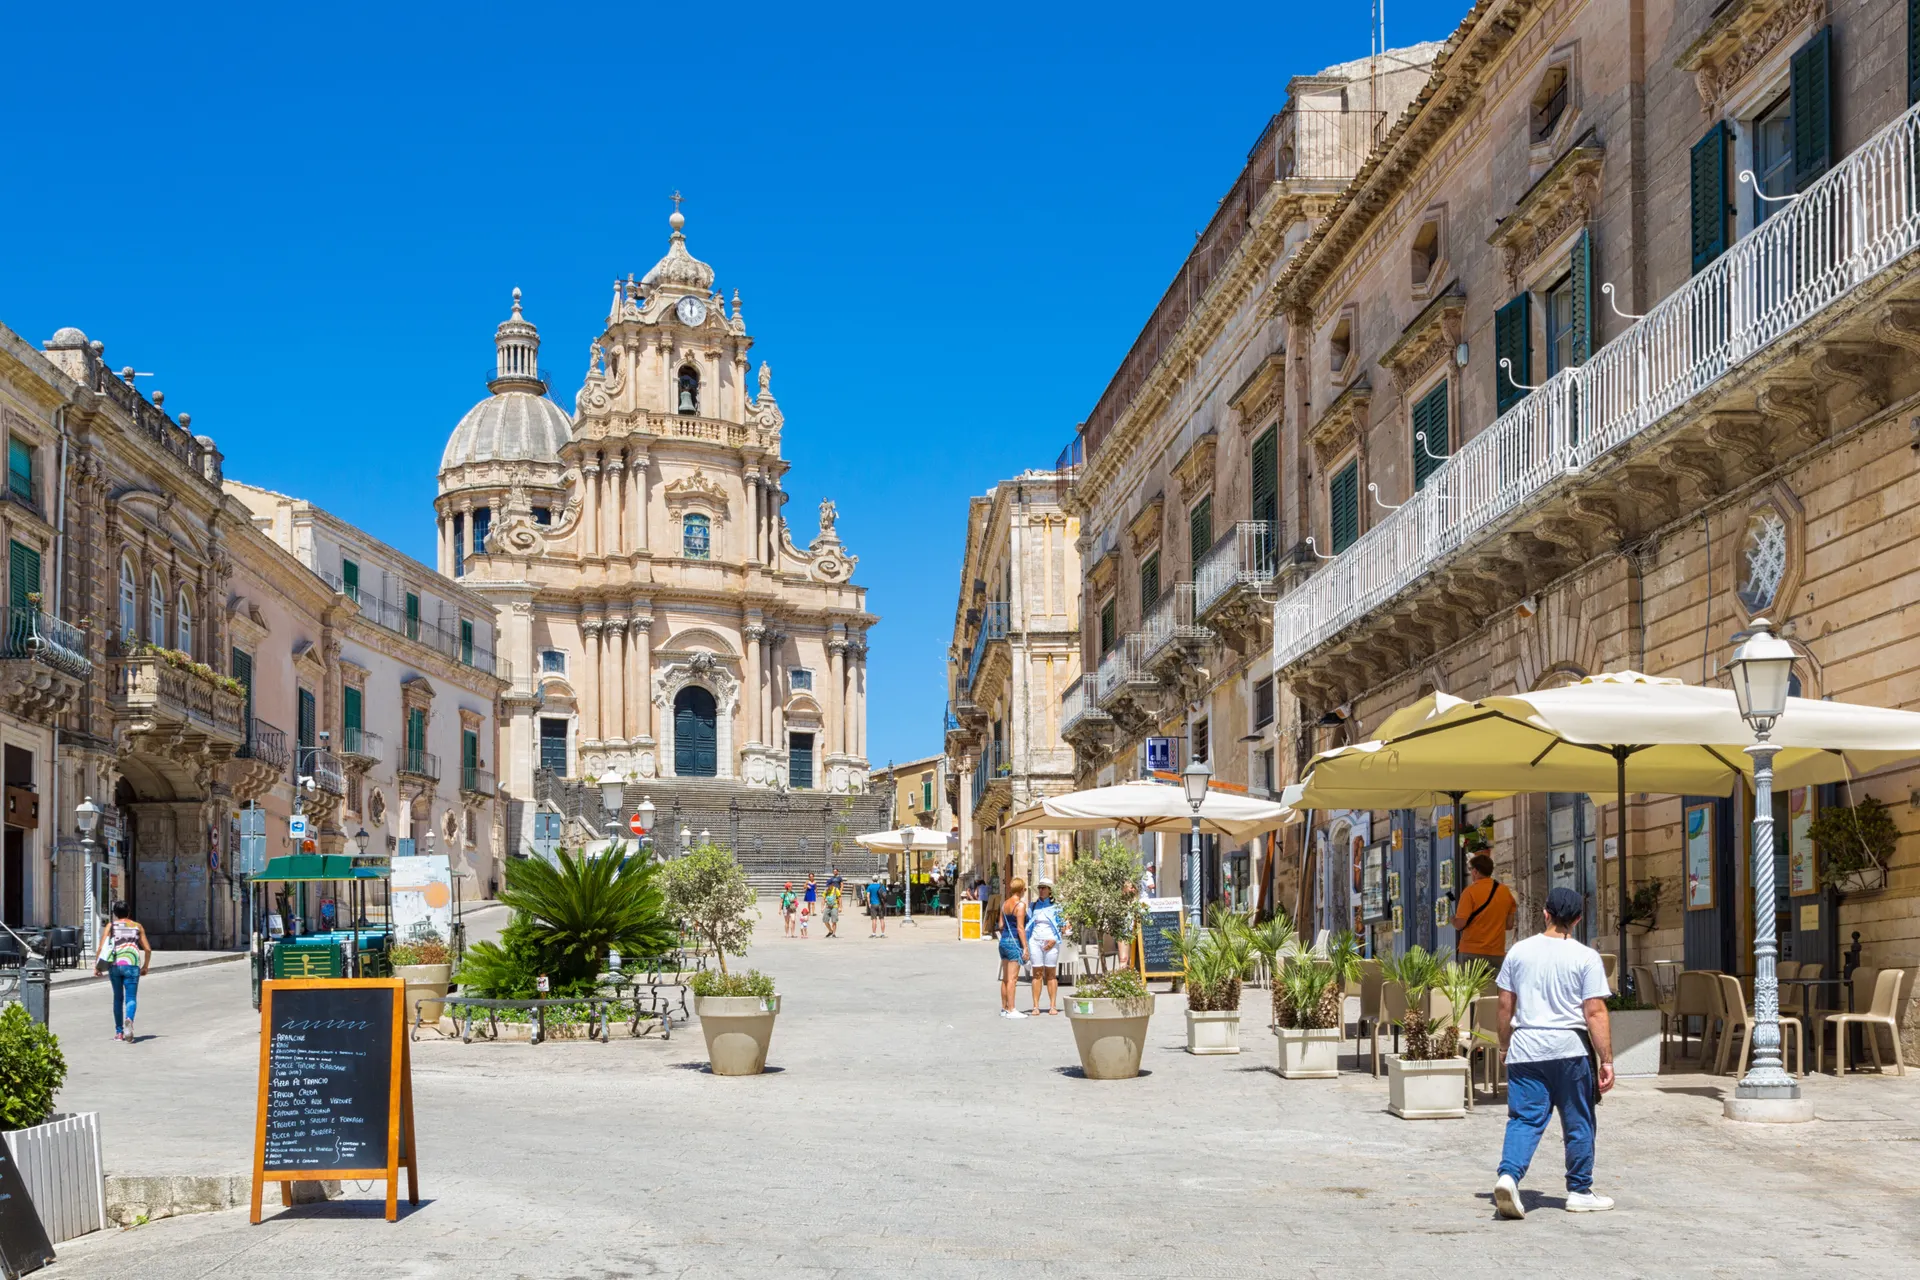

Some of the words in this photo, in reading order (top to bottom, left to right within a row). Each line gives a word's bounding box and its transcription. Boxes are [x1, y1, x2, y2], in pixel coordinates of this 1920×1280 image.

[273, 1078, 290, 1087] PIZZA
[272, 1090, 294, 1098] TAVOLA
[298, 1088, 318, 1096] CALDA
[273, 1100, 289, 1108] COUS
[293, 1098, 306, 1106] COUS
[329, 1097, 353, 1105] VERDURE
